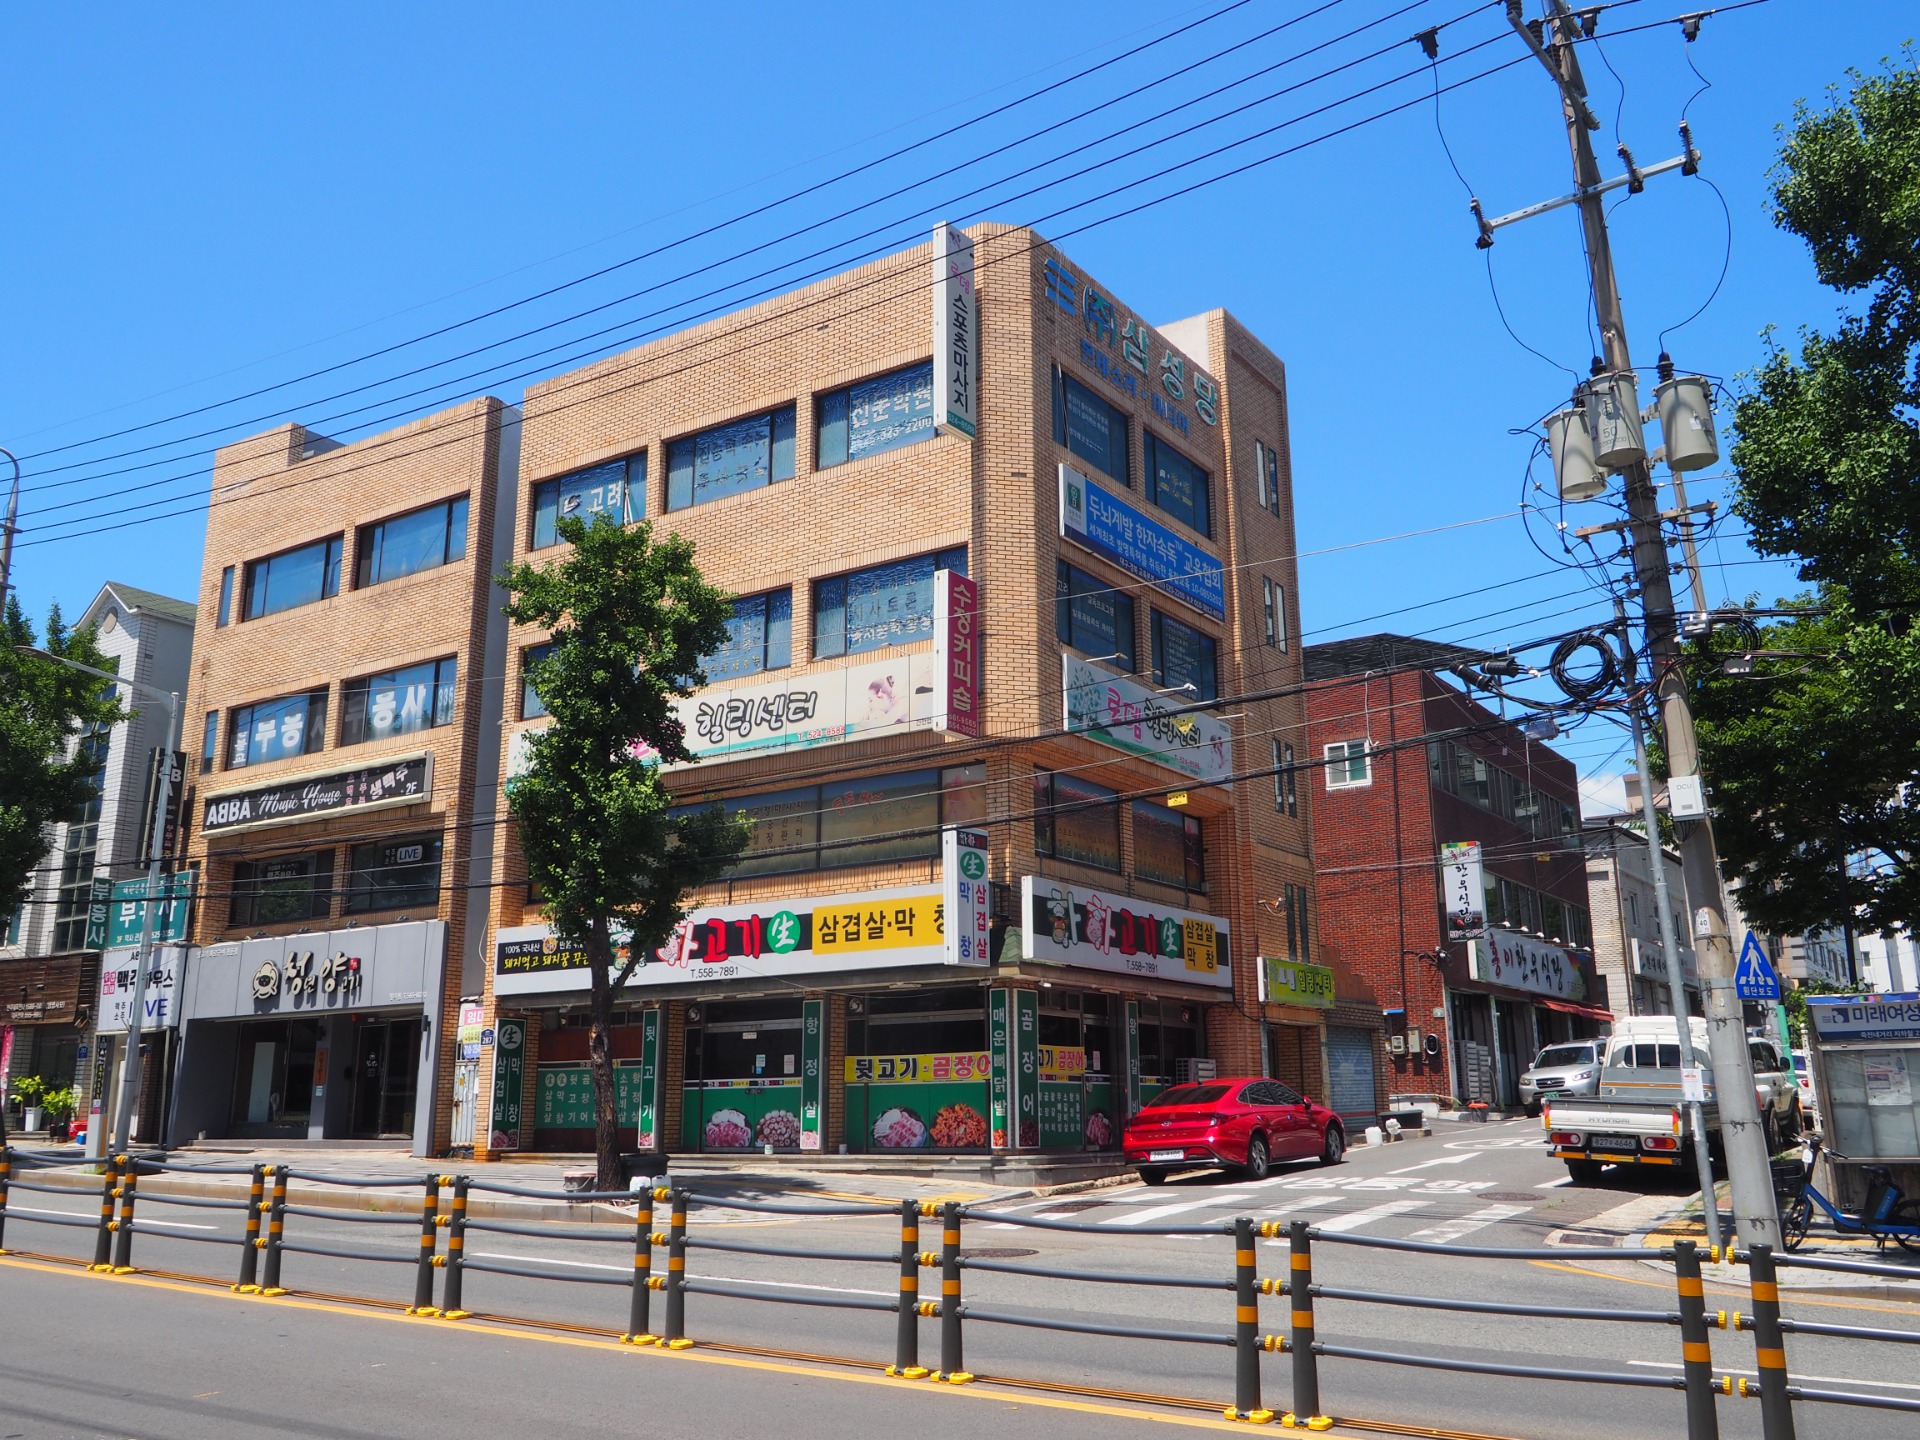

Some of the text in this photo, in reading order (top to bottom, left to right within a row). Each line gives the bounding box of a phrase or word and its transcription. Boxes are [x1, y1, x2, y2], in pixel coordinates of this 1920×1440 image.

[953, 293, 968, 414] 스포츠마사지
[591, 481, 622, 512] 고려
[1088, 495, 1133, 542] 두뇌계발
[1089, 524, 1115, 547] 세계최초
[953, 583, 972, 713] 수정커피숍
[697, 691, 818, 744] 힐링센터
[405, 781, 418, 795] 2F
[1677, 782, 1693, 790] DCU
[206, 799, 251, 826] ABBA
[258, 793, 299, 816] Music
[300, 783, 342, 808] House
[400, 848, 419, 861] LIVE
[963, 854, 981, 876] 生
[1455, 863, 1472, 923] 한우식당
[87, 881, 111, 946] 부흥사
[959, 882, 971, 958] 막창
[975, 884, 987, 960] 삼겹살
[1047, 888, 1157, 959] 하하고기
[772, 913, 795, 948] 生
[1163, 923, 1178, 952] 生
[1185, 920, 1214, 943] 삼겹살
[503, 955, 539, 971] 돼지먹고
[542, 953, 570, 968] 돼지꿈
[504, 943, 540, 954] 100% 국내산
[690, 967, 739, 979] T.558-7891
[1299, 970, 1332, 995] 힐링센터
[1742, 986, 1774, 996] 횡단보도
[113, 1011, 126, 1021] 소주
[482, 1036, 493, 1044] 287
[502, 1027, 519, 1046] 生
[1894, 1029, 1914, 1037] 지하철
[642, 1026, 656, 1119] 뒷고기
[805, 1017, 819, 1119] 항정살
[1021, 1009, 1034, 1116] 곰장어
[493, 1056, 507, 1121] 삼겹살
[509, 1057, 521, 1123] 막창
[568, 1074, 577, 1123] 뒷고기
[580, 1074, 590, 1122] 곰장어
[1588, 1116, 1630, 1124] HYUNDAI
